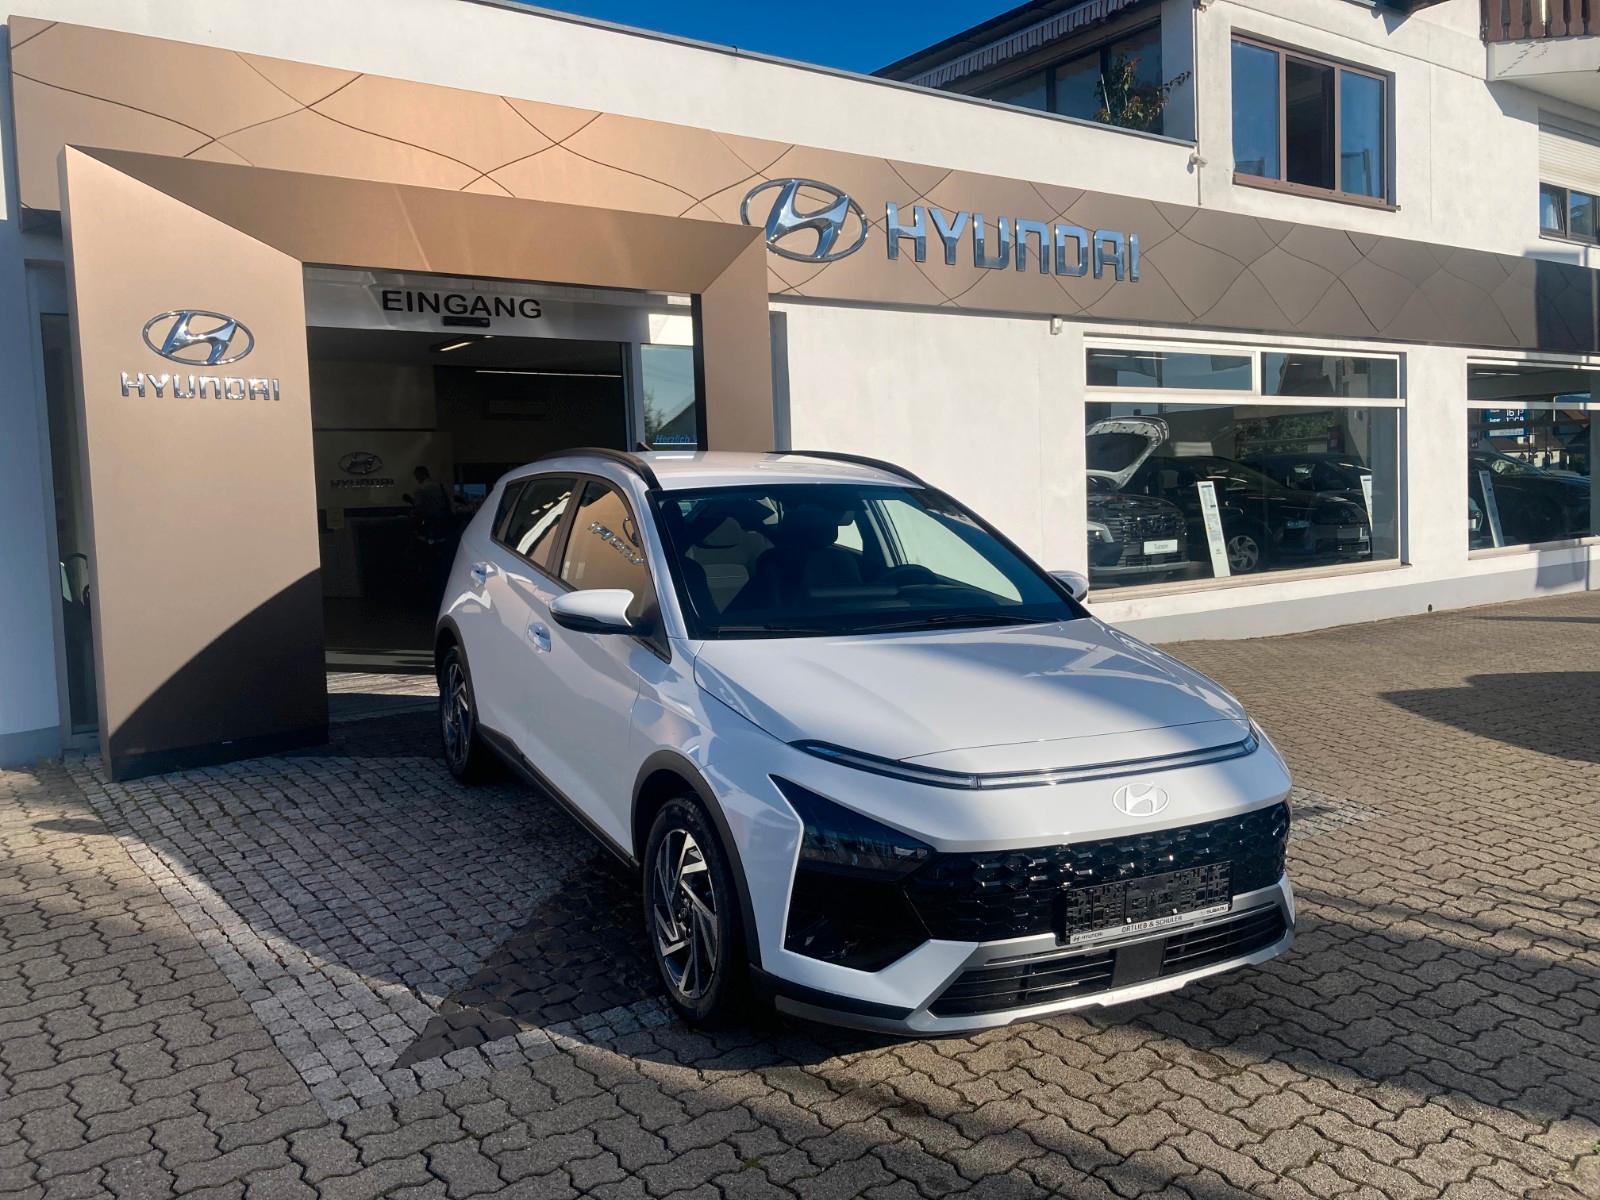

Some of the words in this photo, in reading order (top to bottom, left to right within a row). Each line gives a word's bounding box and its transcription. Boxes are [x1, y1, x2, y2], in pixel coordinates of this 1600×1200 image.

[886, 201, 1140, 282] HYUNDAI
[382, 290, 542, 318] EINGANG
[121, 370, 280, 401] HYUNDAI
[1121, 922, 1148, 933] ORTLIEB
